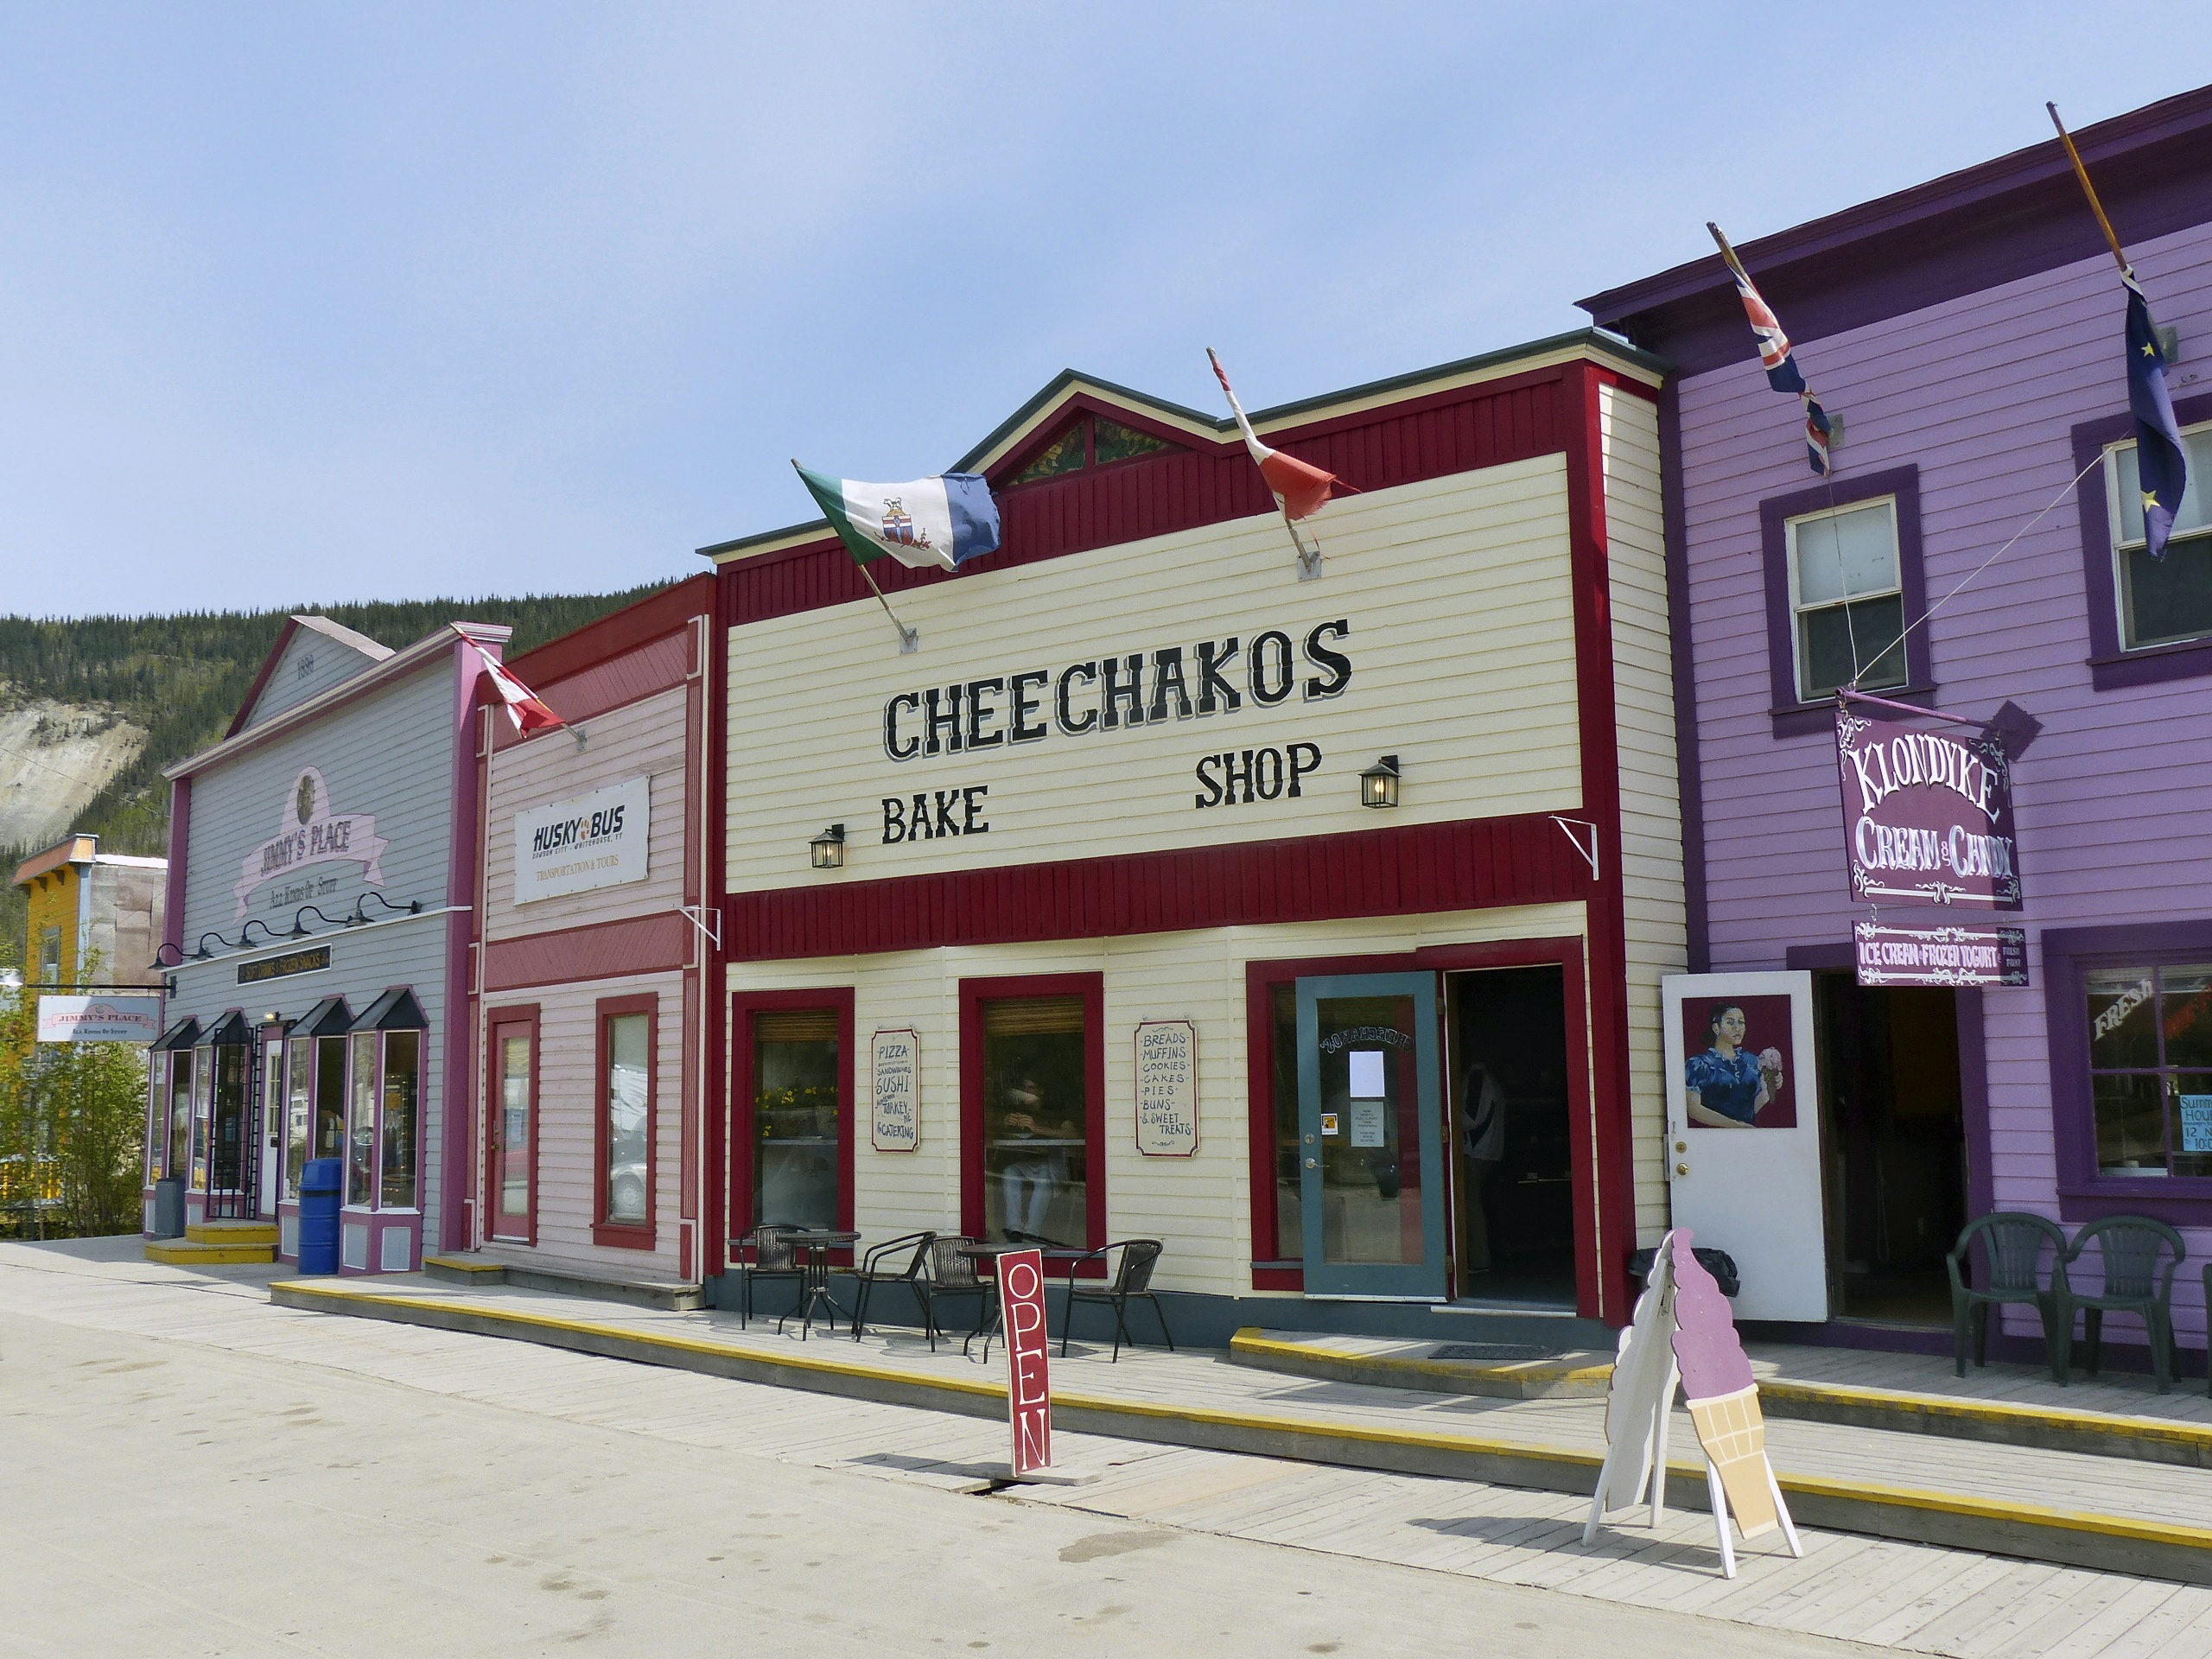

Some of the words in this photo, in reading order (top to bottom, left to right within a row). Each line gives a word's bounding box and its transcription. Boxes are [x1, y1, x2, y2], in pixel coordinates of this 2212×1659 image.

[884, 619, 1353, 762] CHEECHAKOS
[1847, 734, 1999, 824] KLONDYKE
[881, 785, 988, 844] BAKE
[1196, 742, 1322, 809] SHOP
[533, 817, 582, 852] HUSKY
[590, 804, 625, 838] BUS
[261, 830, 305, 876] JIMMY'S
[310, 821, 352, 855] PLACE
[532, 849, 552, 859] DAWSON
[555, 846, 568, 855] CITY
[574, 836, 613, 849] WHITEHORSE,
[615, 832, 623, 841] YT
[1856, 816, 1941, 871] CREAM
[1949, 825, 2013, 880] CANDY
[537, 861, 589, 881] TRANSPORTATION
[590, 860, 595, 870] &
[597, 855, 619, 869] TOURS
[1859, 941, 1882, 966] ICE
[1881, 942, 1919, 966] CREAM
[1921, 944, 1961, 967] FROZEN
[1960, 945, 1998, 968] YOGURT
[1143, 1033, 1185, 1047] BREADS
[879, 1045, 907, 1059] PIZZA
[1142, 1047, 1186, 1060] MUFFINS
[877, 1067, 912, 1076] SANDWICHES
[1143, 1061, 1186, 1071] COOKIES
[876, 1076, 909, 1095] SUSHI
[1144, 1074, 1185, 1083] CAKES
[1144, 1086, 1174, 1096] PIES
[882, 1101, 907, 1115] TURKEY
[1142, 1099, 1171, 1110] BUNS
[1142, 1113, 1148, 1123] &
[1151, 1113, 1179, 1123] SWEET
[881, 1123, 913, 1140] CATERING
[1160, 1123, 1192, 1135] TREATS
[2186, 1127, 2196, 1137] 12
[1008, 1263, 1046, 1470] OPEN
